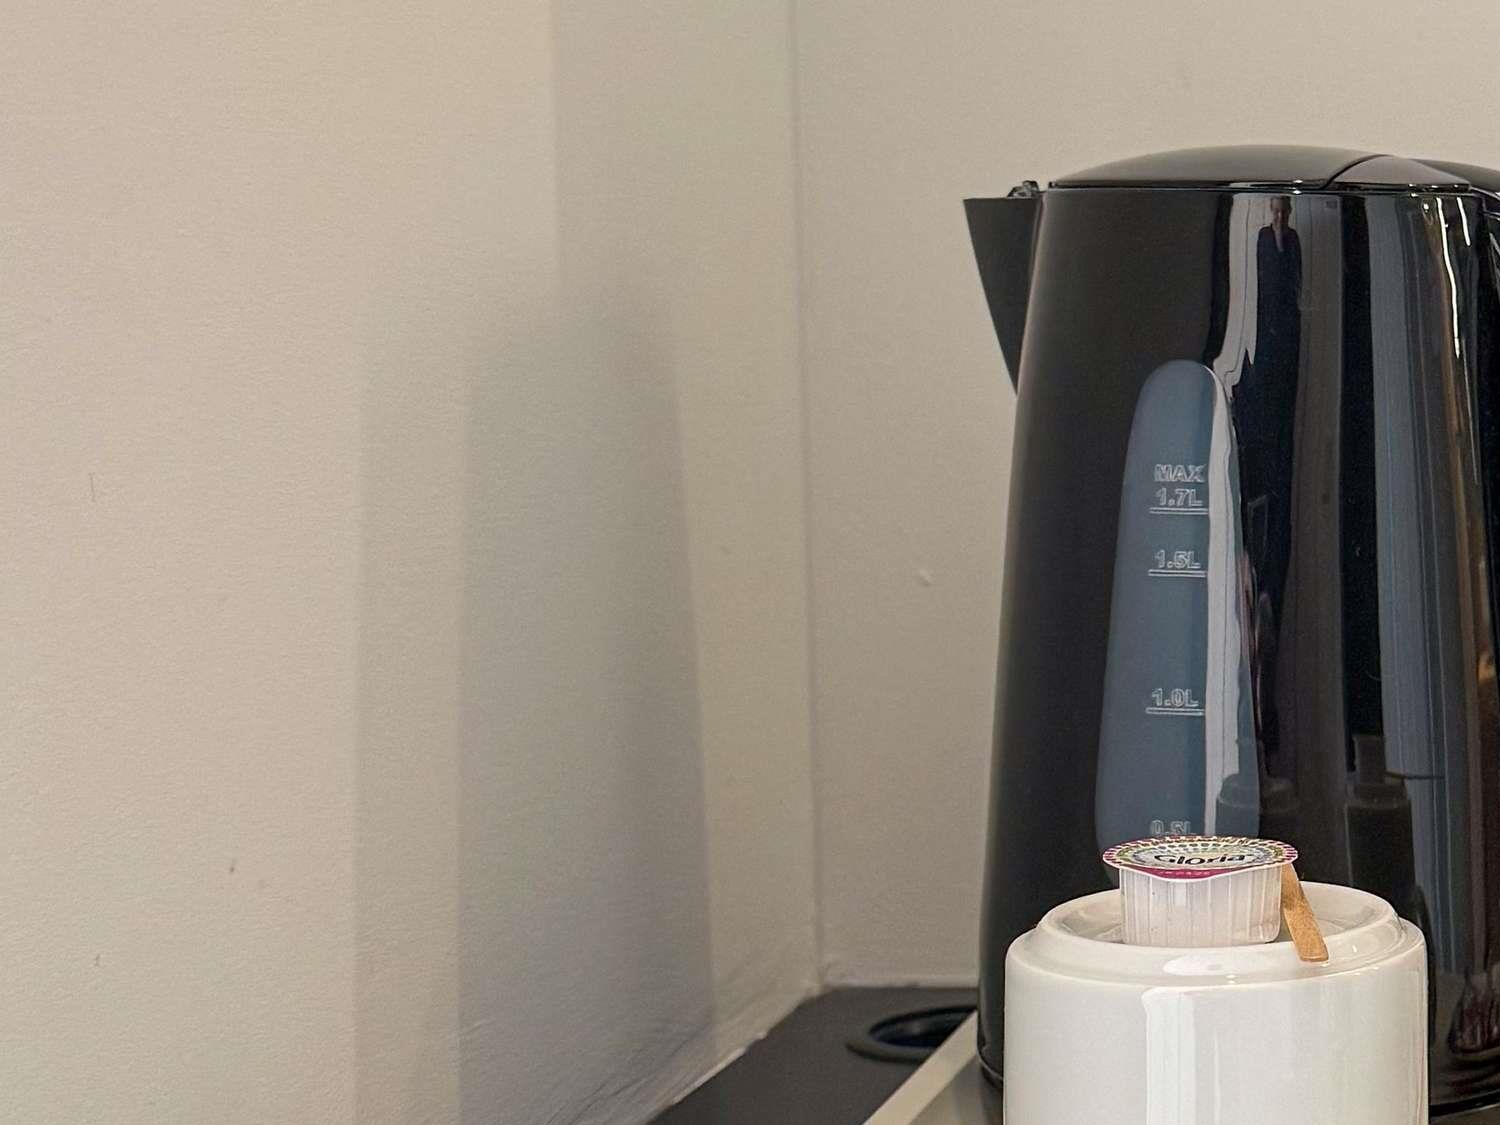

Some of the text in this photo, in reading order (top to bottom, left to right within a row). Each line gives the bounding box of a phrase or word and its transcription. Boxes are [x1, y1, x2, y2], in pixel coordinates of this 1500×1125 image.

[1153, 463, 1207, 483] MAX
[1154, 487, 1204, 507] 1.7L
[1153, 548, 1201, 570] 1.5L
[1151, 687, 1200, 708] 1.0L
[1153, 854, 1246, 866] Gloria
